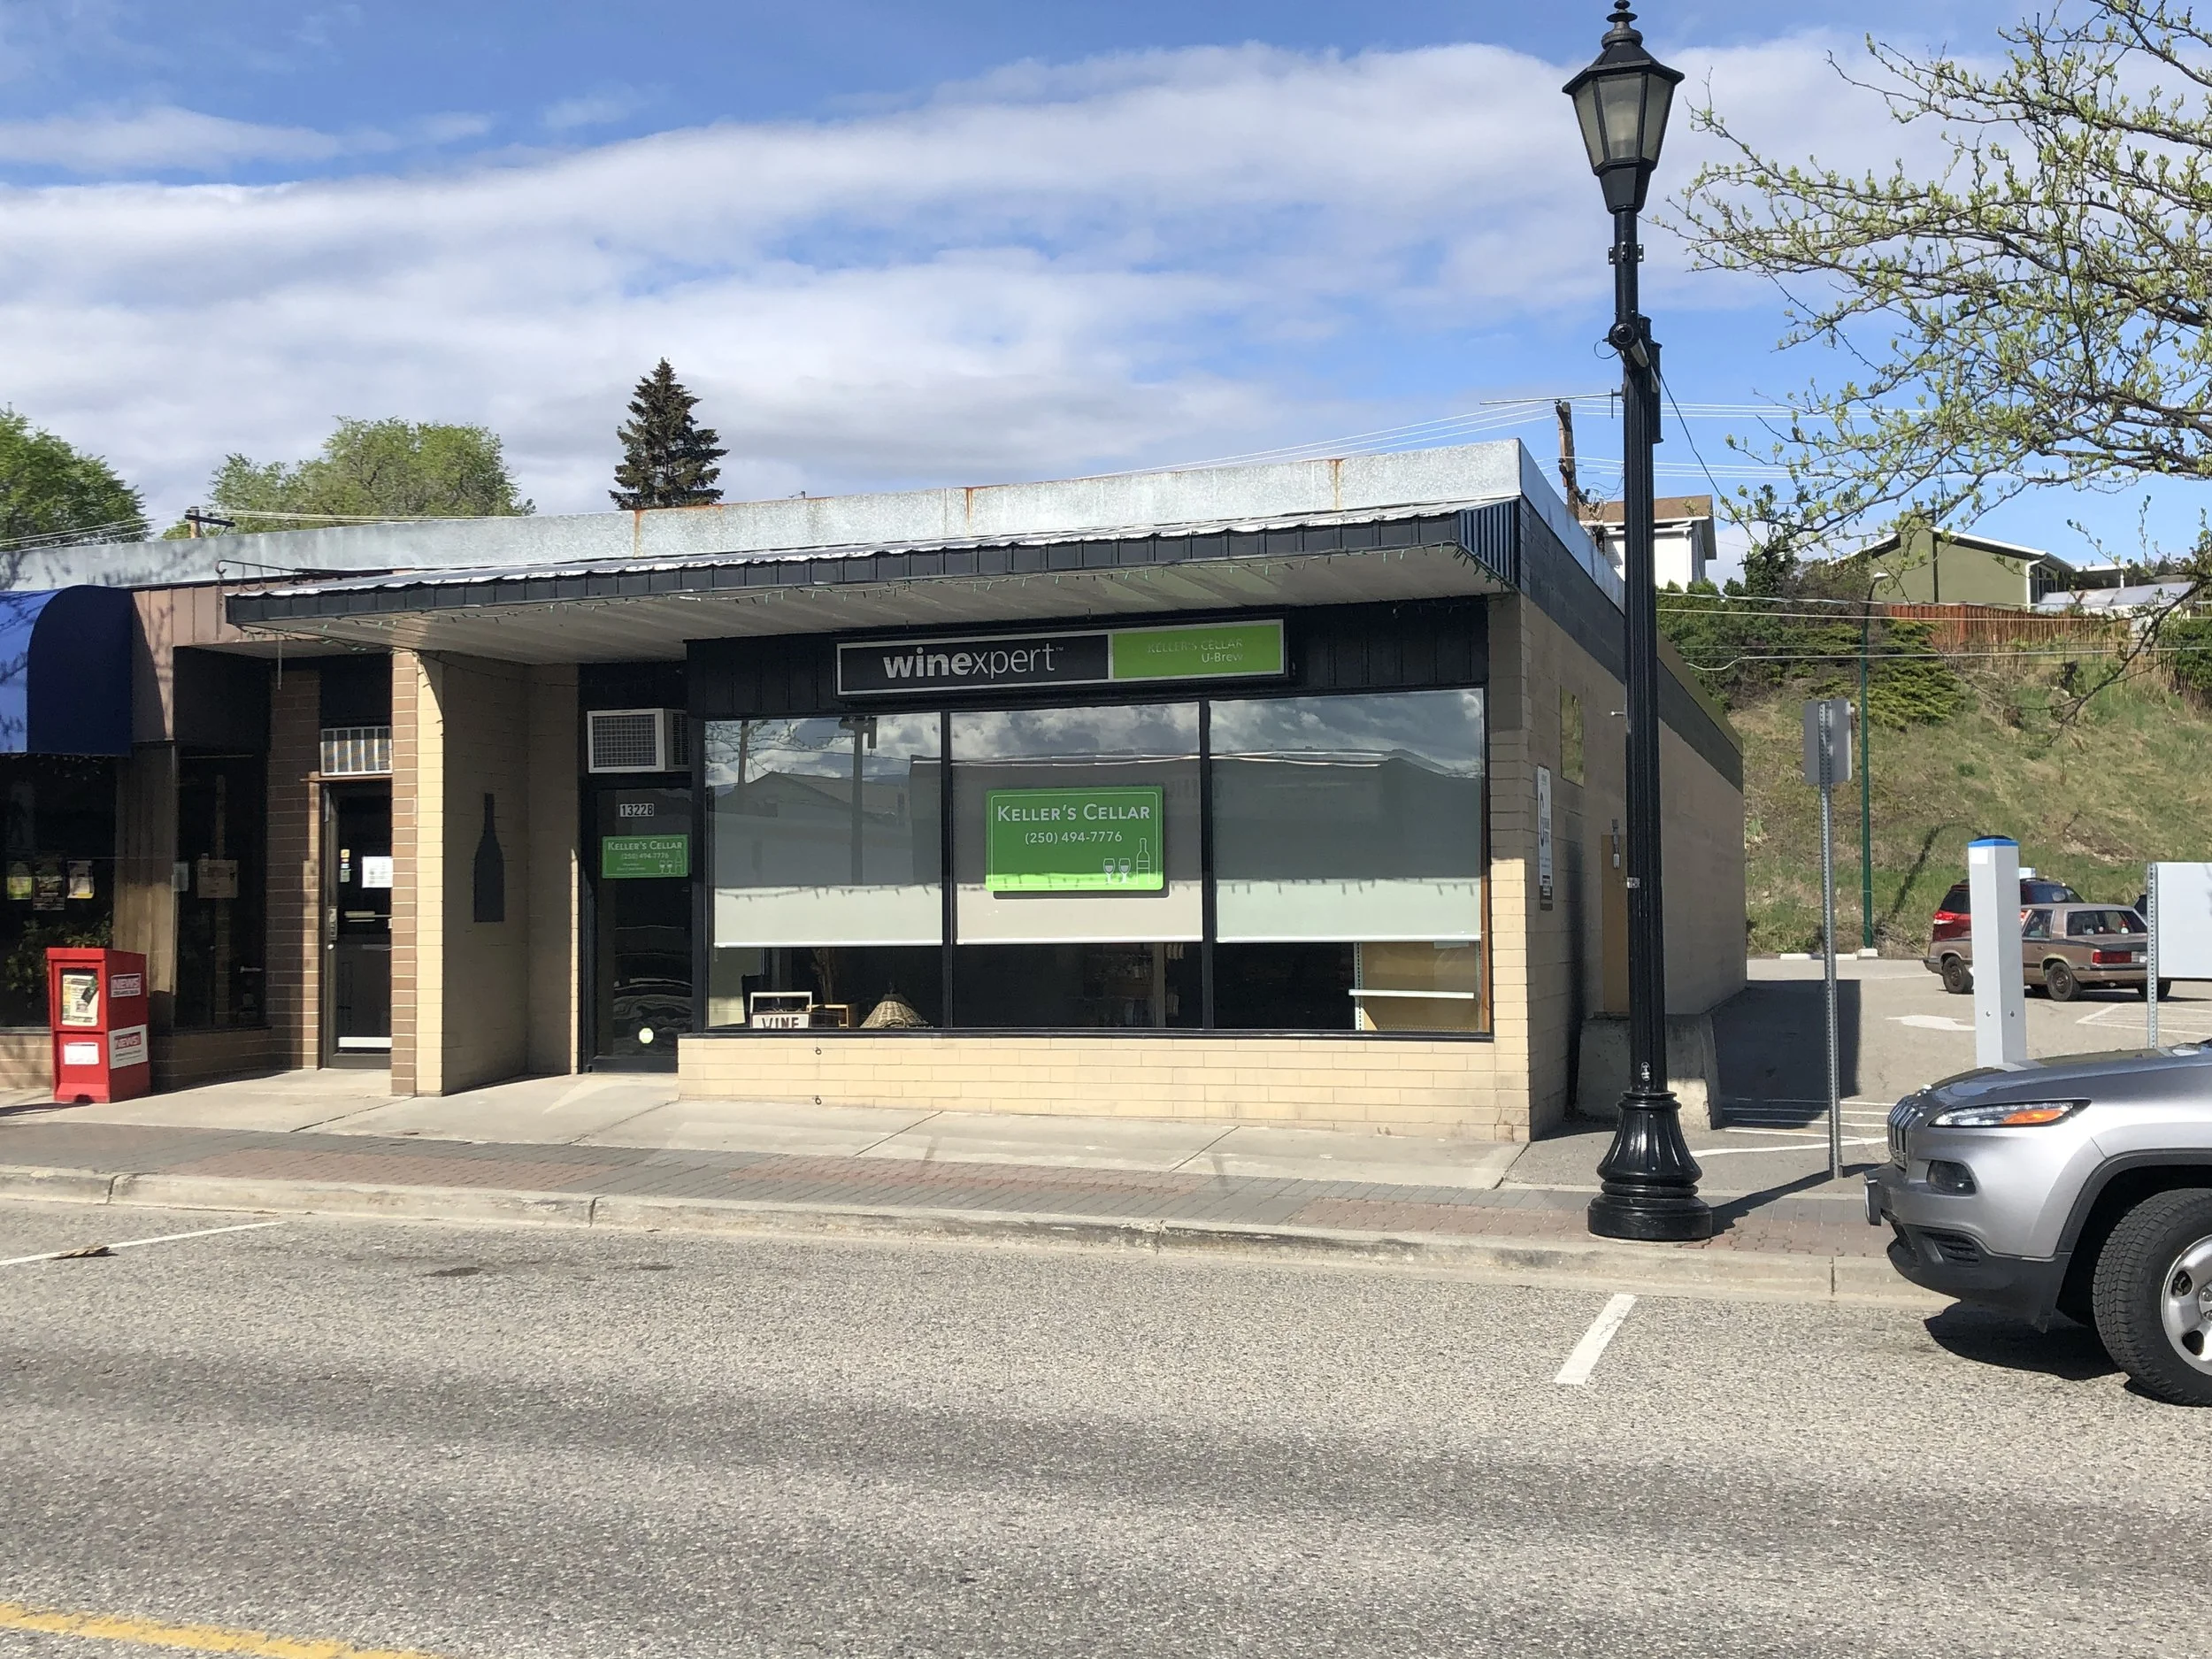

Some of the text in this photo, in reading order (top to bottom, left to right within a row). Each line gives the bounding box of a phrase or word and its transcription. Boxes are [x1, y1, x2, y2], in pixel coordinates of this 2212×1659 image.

[1201, 638, 1243, 650] CELLAR
[883, 642, 1056, 680] winexpert
[1202, 652, 1243, 664] U-Brew
[997, 803, 1150, 822] KELLER'S CELLAR
[1025, 831, 1123, 845] (250) 494-7776
[608, 840, 682, 850] KELLER'S CELLAR
